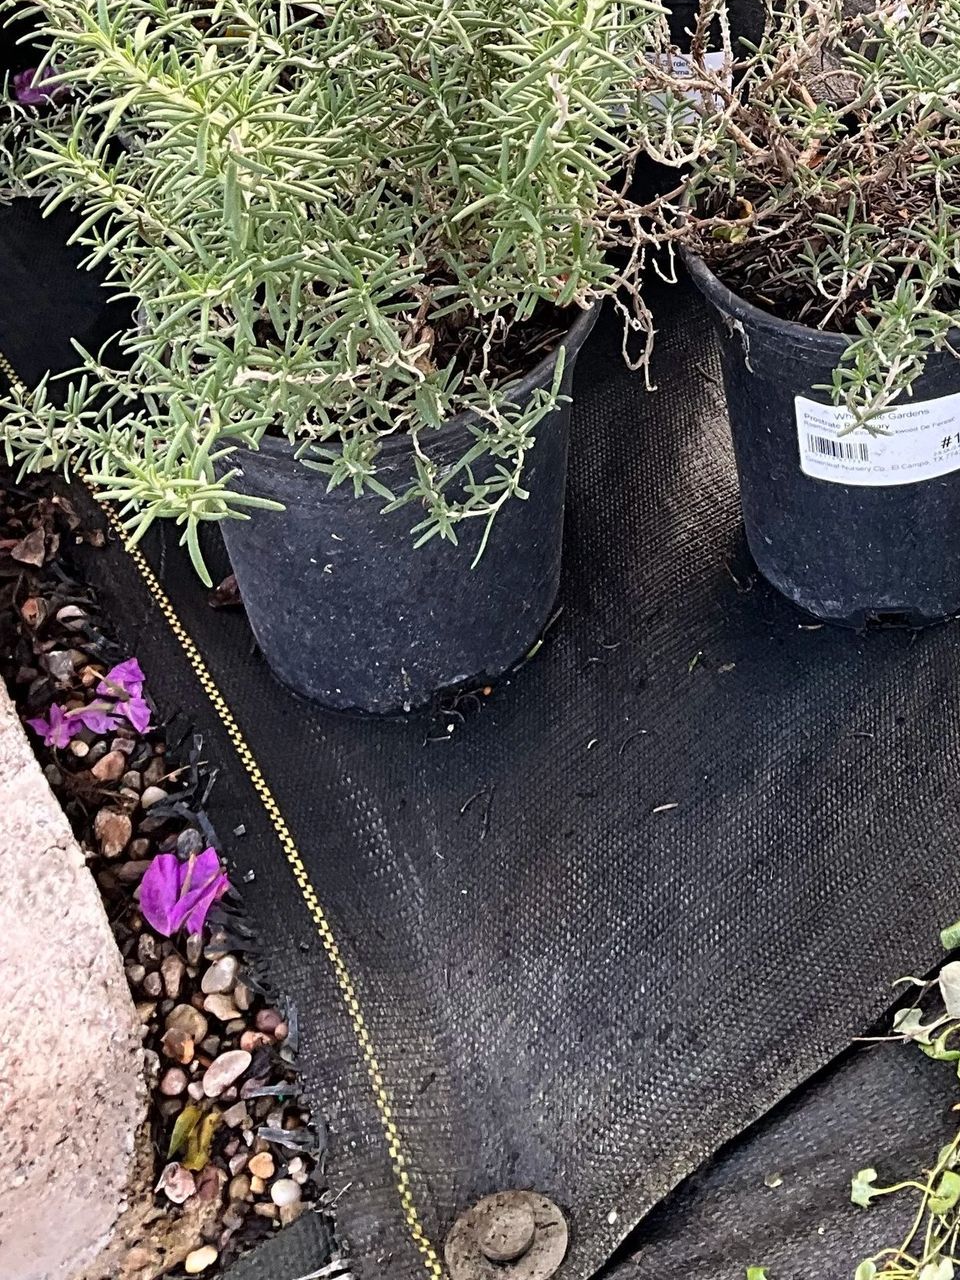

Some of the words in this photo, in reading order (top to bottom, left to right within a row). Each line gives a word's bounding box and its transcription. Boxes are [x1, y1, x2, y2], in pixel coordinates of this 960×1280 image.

[804, 412, 841, 429] Prostrate
[888, 409, 930, 420] Gardens
[941, 431, 960, 449] #1
[842, 464, 872, 472] Nursery
